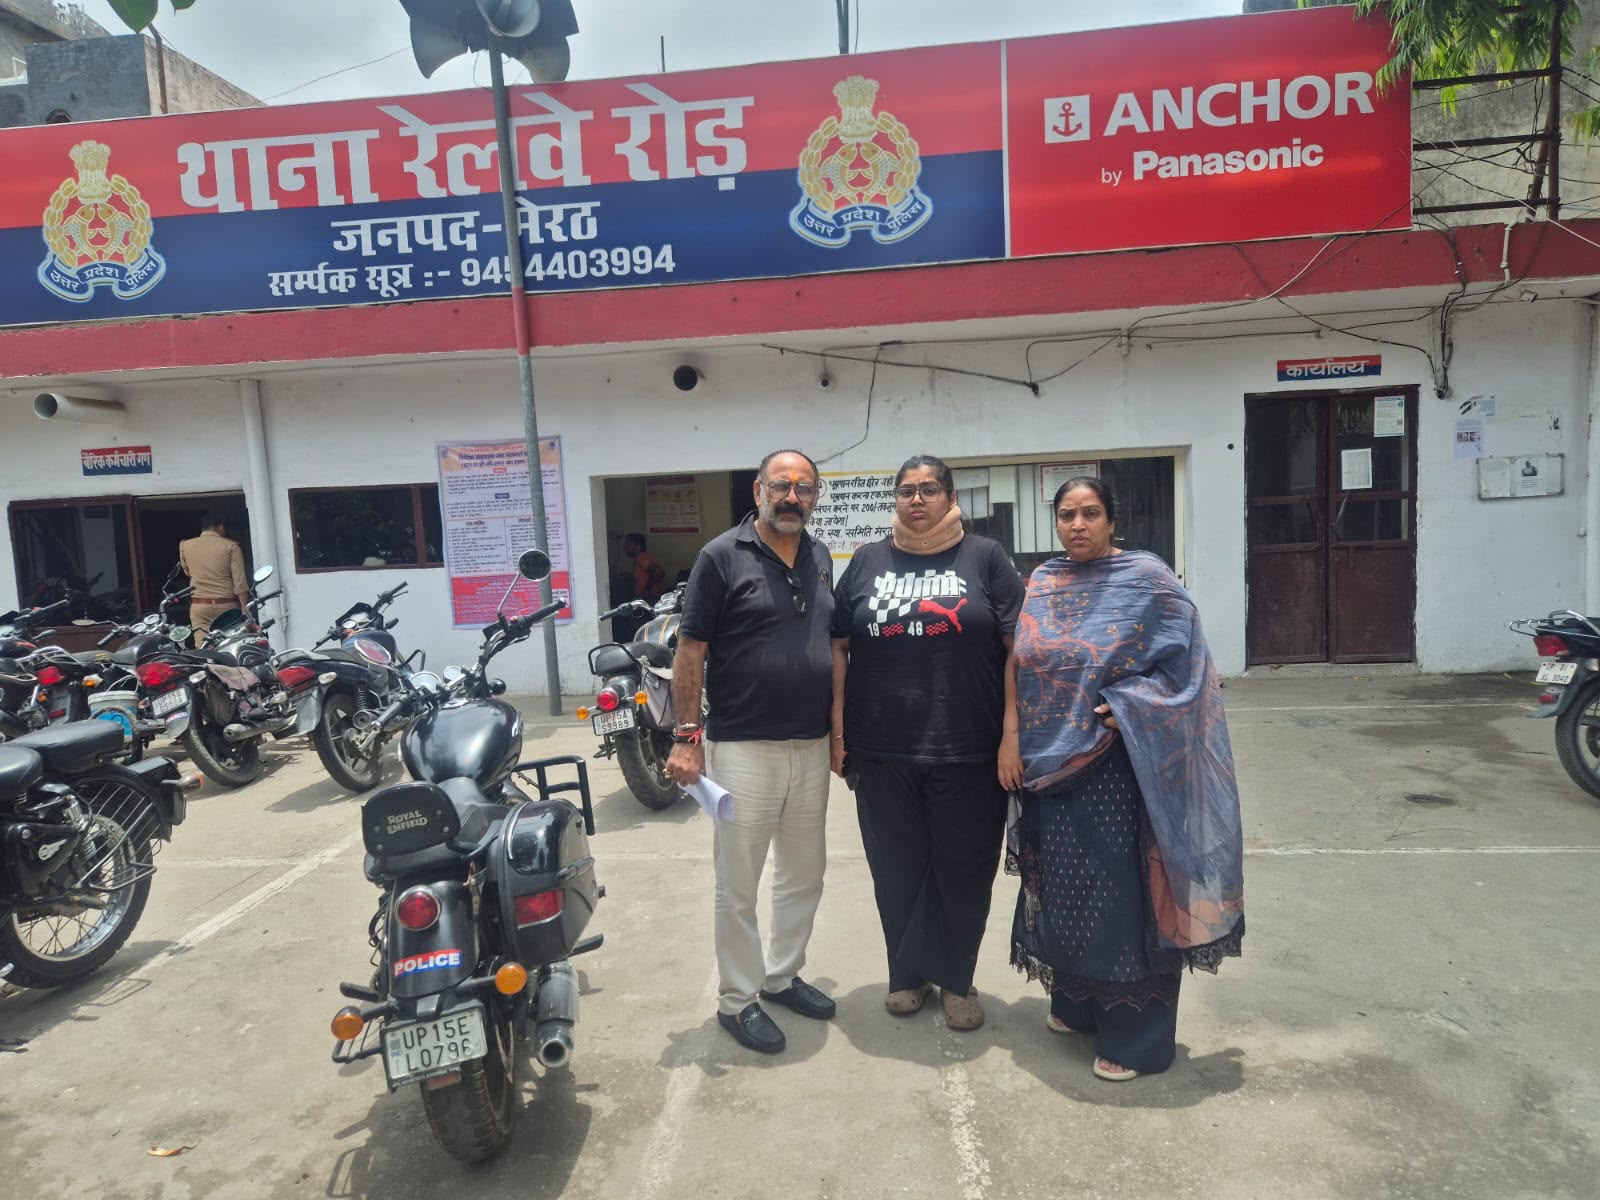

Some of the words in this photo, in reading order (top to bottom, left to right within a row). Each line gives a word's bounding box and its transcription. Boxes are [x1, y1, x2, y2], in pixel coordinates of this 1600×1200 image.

[1103, 71, 1375, 137] ANCHOR
[177, 129, 380, 213] थाना
[375, 92, 594, 198] रेलवे
[611, 83, 755, 191] रोड़
[1101, 167, 1122, 187] by
[1133, 137, 1324, 181] Panasonic
[803, 214, 835, 237] उत्तर
[841, 206, 880, 223] प्रदेश
[887, 202, 923, 233] पुलिस
[50, 270, 79, 292] उत्तर
[83, 264, 119, 279] प्रदेश
[125, 260, 157, 290] पुलिस
[364, 264, 414, 298] सूत्र
[1286, 358, 1370, 377] कार्यालय
[867, 622, 880, 637] 19
[907, 621, 923, 637] 48
[387, 810, 422, 825] ROYAL
[394, 953, 461, 977] POLICE
[403, 1015, 470, 1049] UP15E
[406, 1038, 475, 1072] L0796
